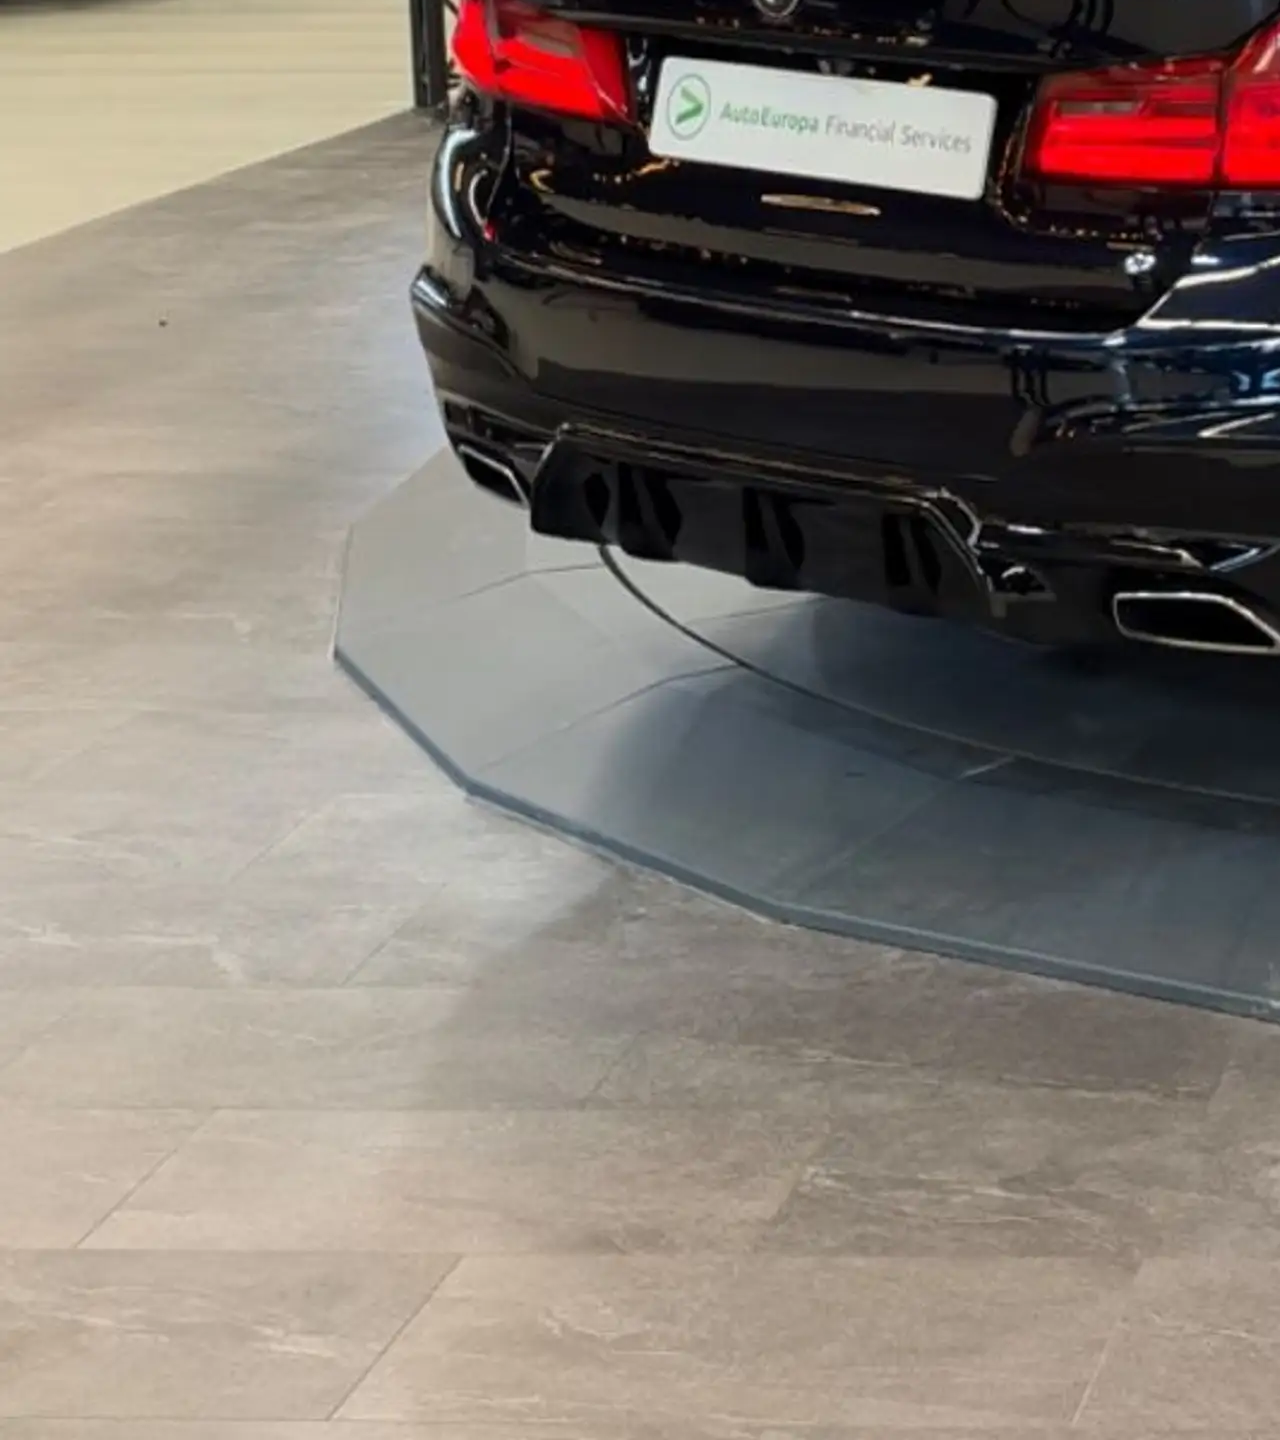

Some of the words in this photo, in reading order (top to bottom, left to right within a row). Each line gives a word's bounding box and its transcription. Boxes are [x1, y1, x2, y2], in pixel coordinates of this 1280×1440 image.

[721, 102, 818, 134] AutoEuropa
[825, 114, 895, 146] Financial
[900, 125, 972, 154] Services
